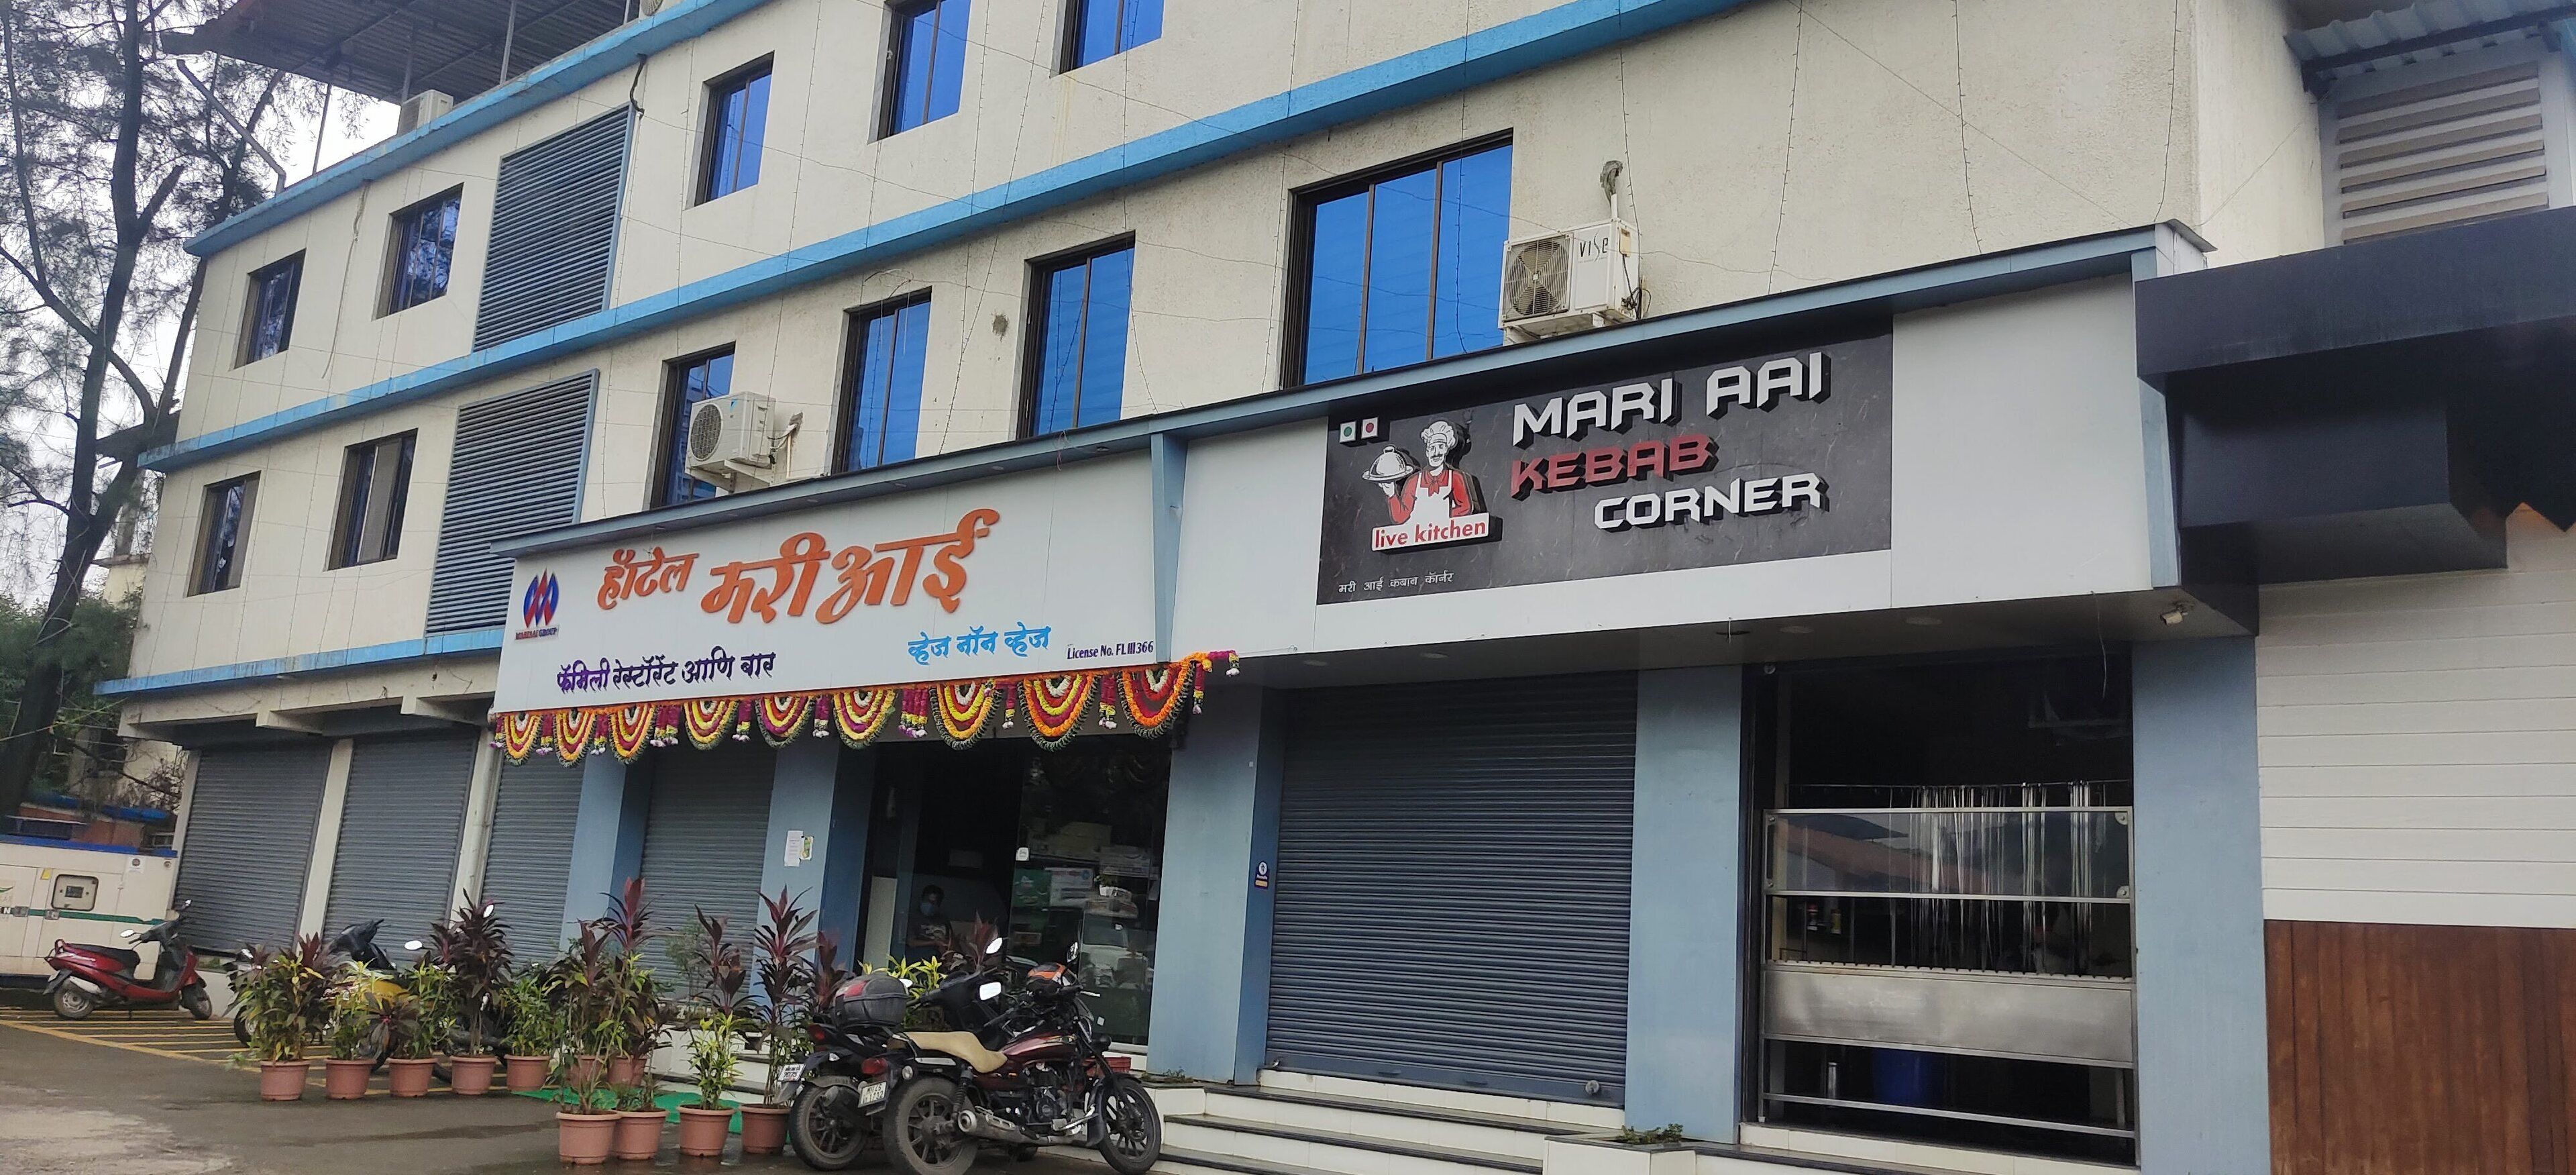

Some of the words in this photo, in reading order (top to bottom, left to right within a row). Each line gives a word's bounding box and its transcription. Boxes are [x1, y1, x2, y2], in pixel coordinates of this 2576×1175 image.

[1512, 378, 1673, 447] MARI
[1706, 352, 1823, 416] AAI
[1511, 433, 1714, 498] KEBAB
[1594, 472, 1821, 529] CORNER
[1375, 529, 1409, 548] live
[1414, 519, 1486, 544] kitchen
[596, 546, 700, 611] हॉटेल
[1338, 580, 1357, 593] मरी
[1363, 576, 1384, 592] आई
[1424, 569, 1454, 584] कॉर्नर
[908, 631, 951, 666] व्हेज
[956, 625, 998, 656] नॉन
[1004, 621, 1052, 657] व्हेज
[1067, 647, 1099, 660] License
[1100, 644, 1114, 657] No.
[557, 657, 611, 695] फॅमिली
[682, 646, 736, 684] आणि
[740, 652, 777, 678] बार
